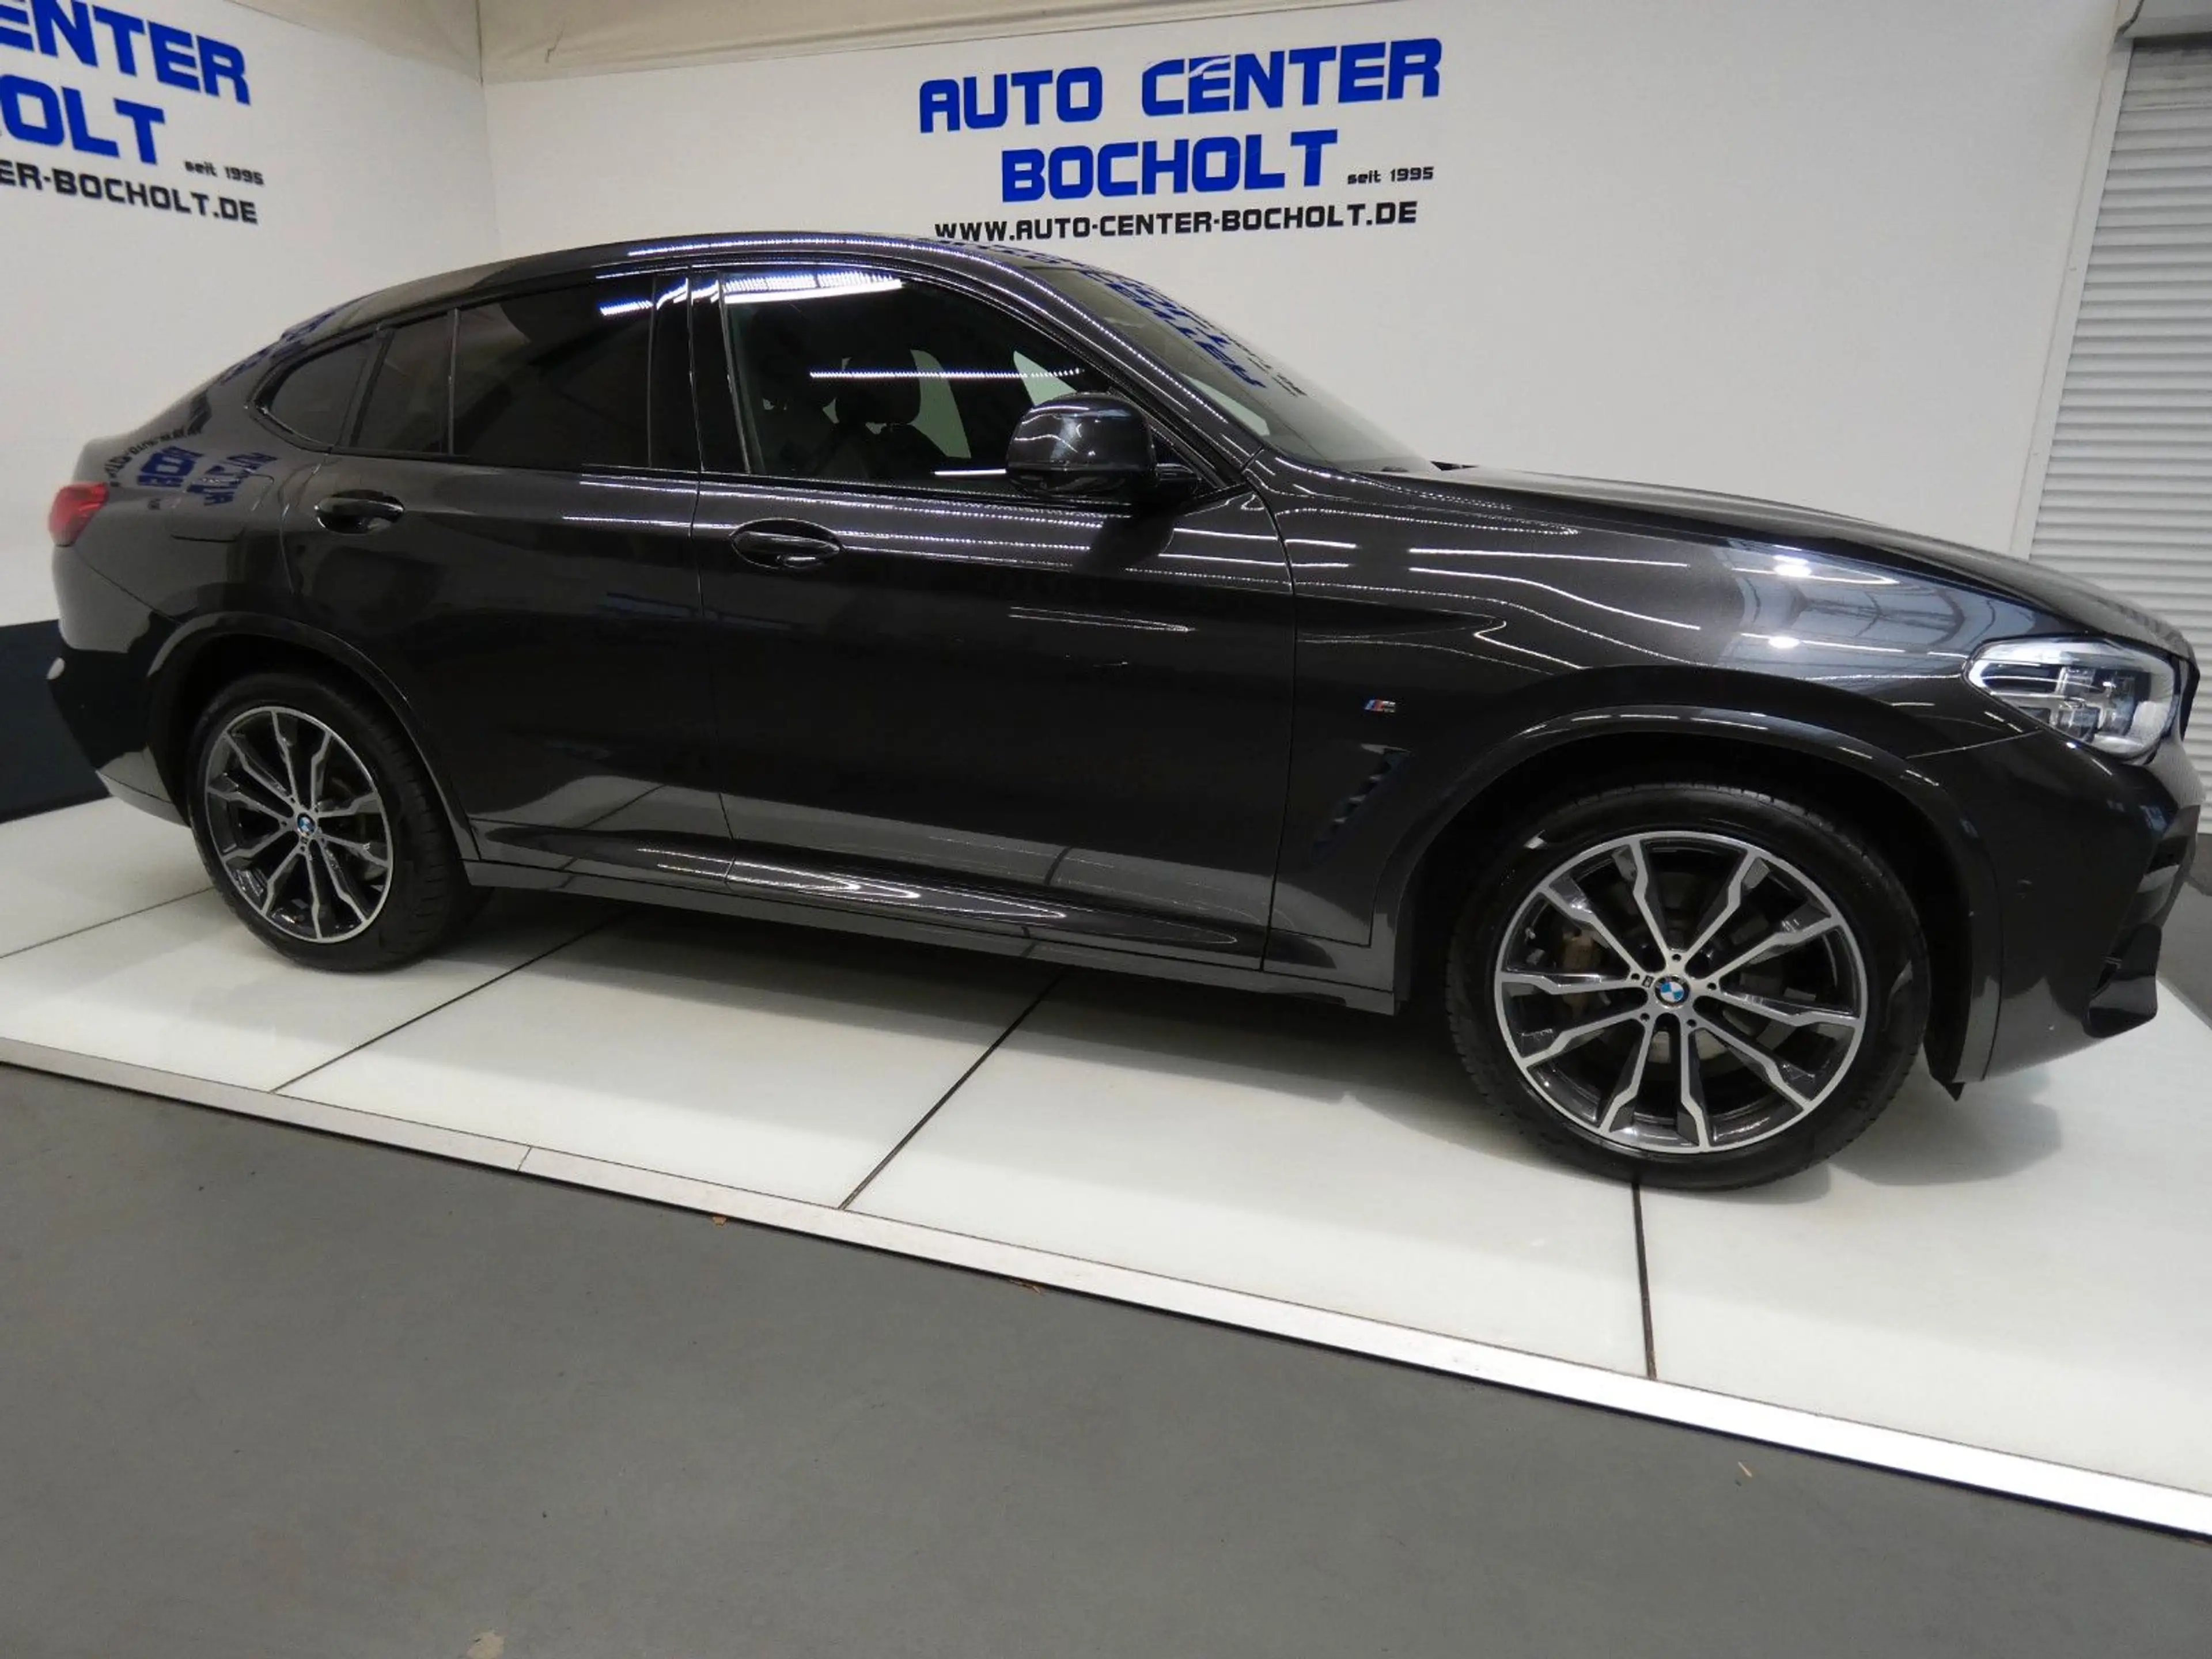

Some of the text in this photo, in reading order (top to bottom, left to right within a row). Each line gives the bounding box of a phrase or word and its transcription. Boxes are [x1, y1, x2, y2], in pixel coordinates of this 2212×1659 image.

[919, 38, 1442, 134] AUTO CENTER
[224, 165, 265, 186] 1995
[1002, 129, 1434, 203] BOCHOLT seit 1995
[934, 200, 1418, 242] WWW.AUTO-CENTER-BOCHOLT.DE
